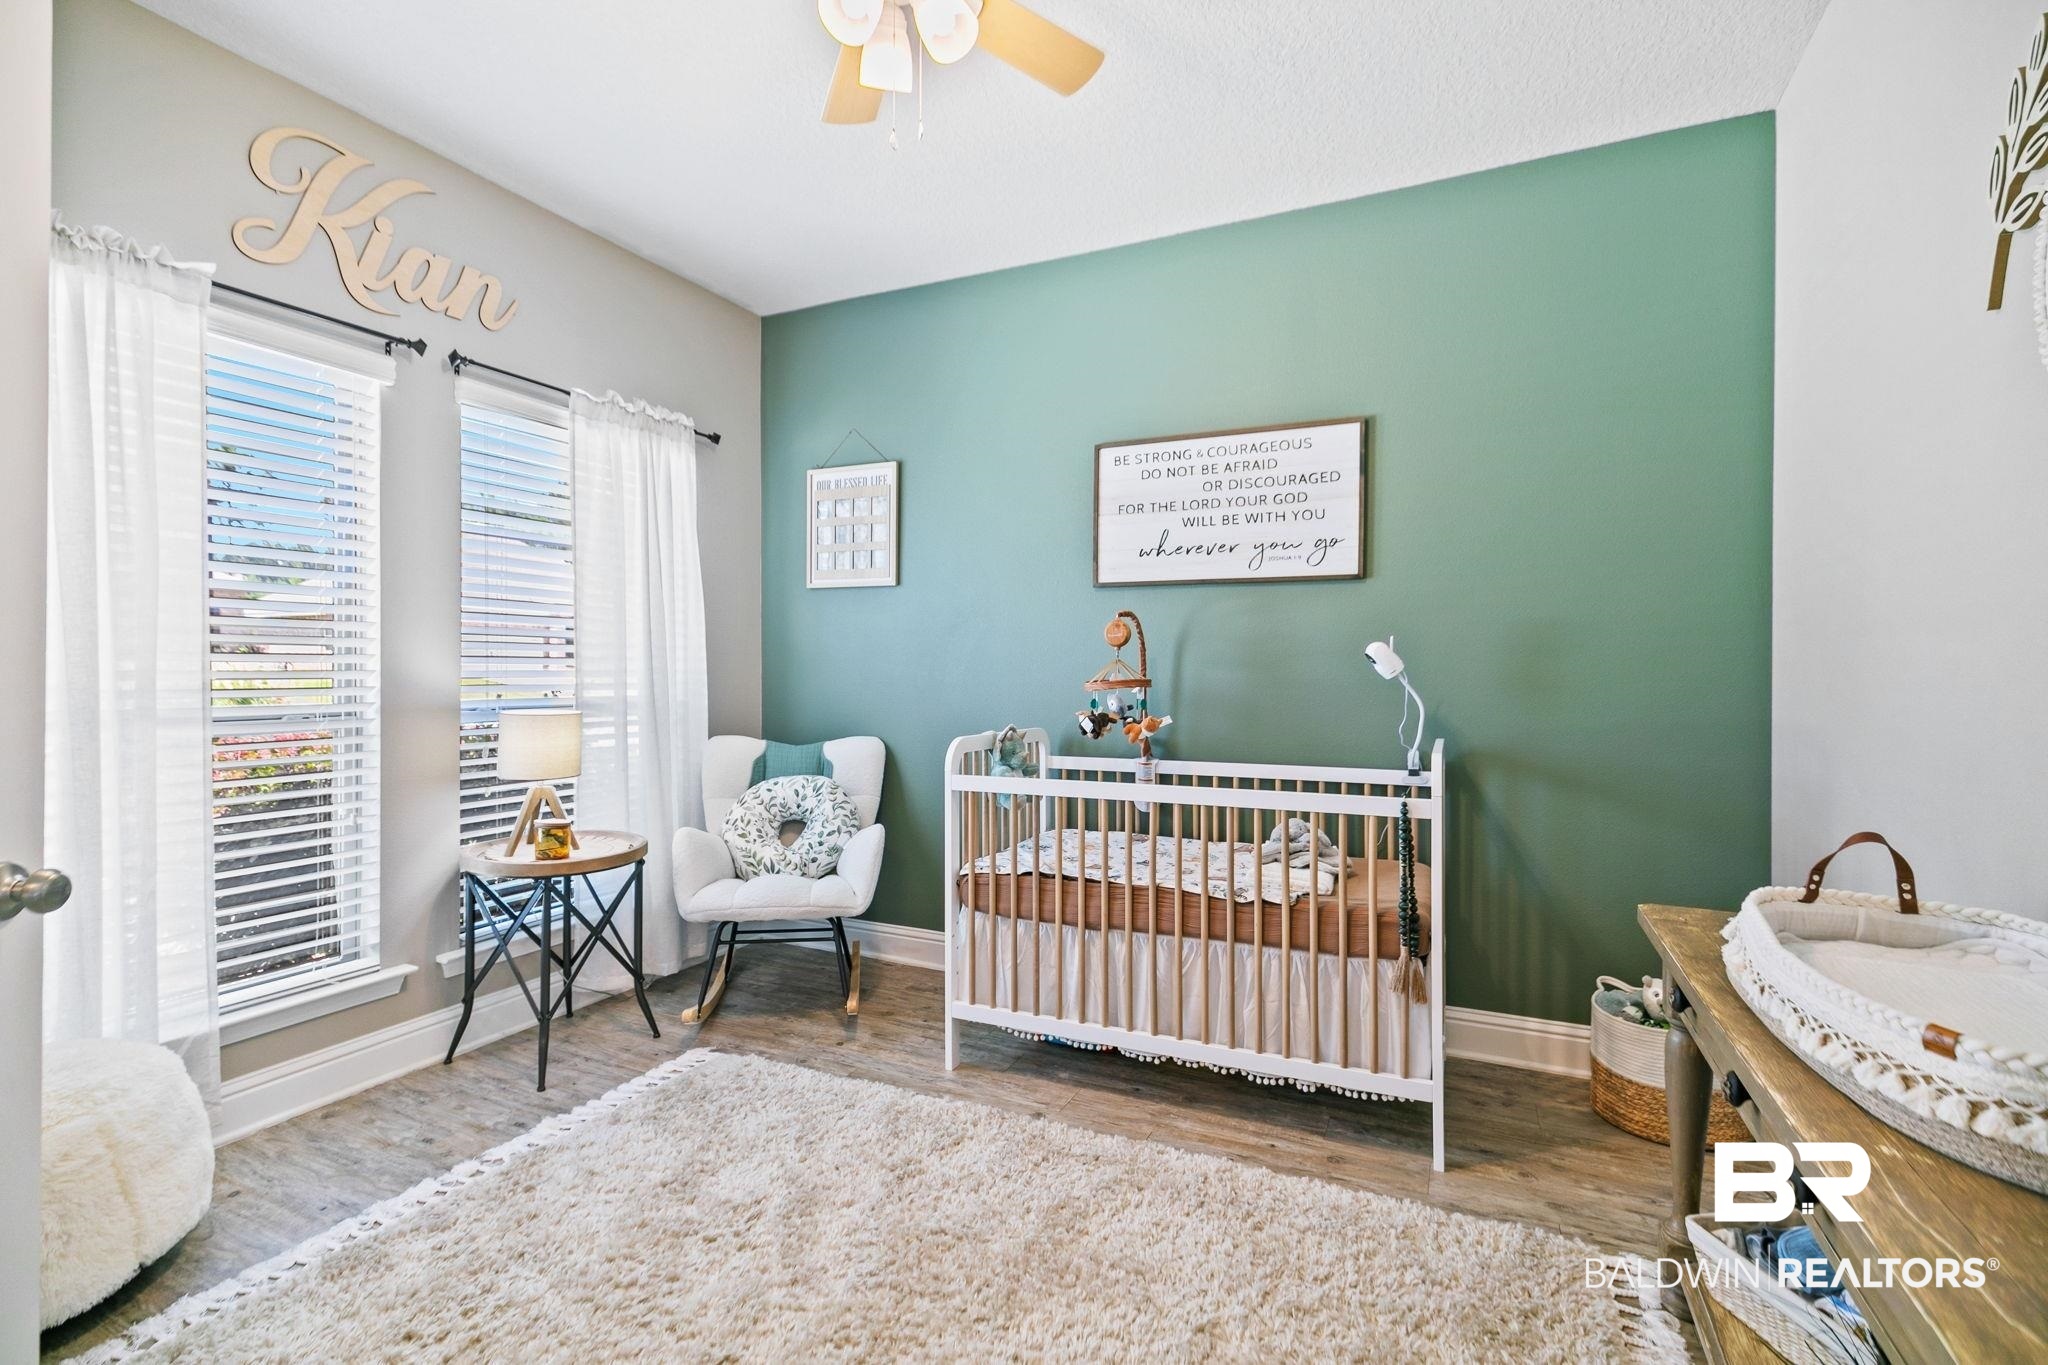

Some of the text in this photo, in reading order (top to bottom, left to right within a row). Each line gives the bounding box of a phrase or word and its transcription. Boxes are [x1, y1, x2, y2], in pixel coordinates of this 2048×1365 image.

[231, 127, 519, 331] Kian
[1114, 438, 1312, 466] BE STRONG & COURAGEOUS
[1142, 458, 1278, 480] DO NOT BE AFRAID
[817, 474, 887, 490] OUR BLESSED LIFE
[1203, 470, 1340, 492] OR DISCOURAGED
[1118, 492, 1307, 515] FOR THE LORD YOUR GOD
[1182, 509, 1325, 528] WILL BE WITH YOU
[1139, 529, 1346, 571] wherever you go
